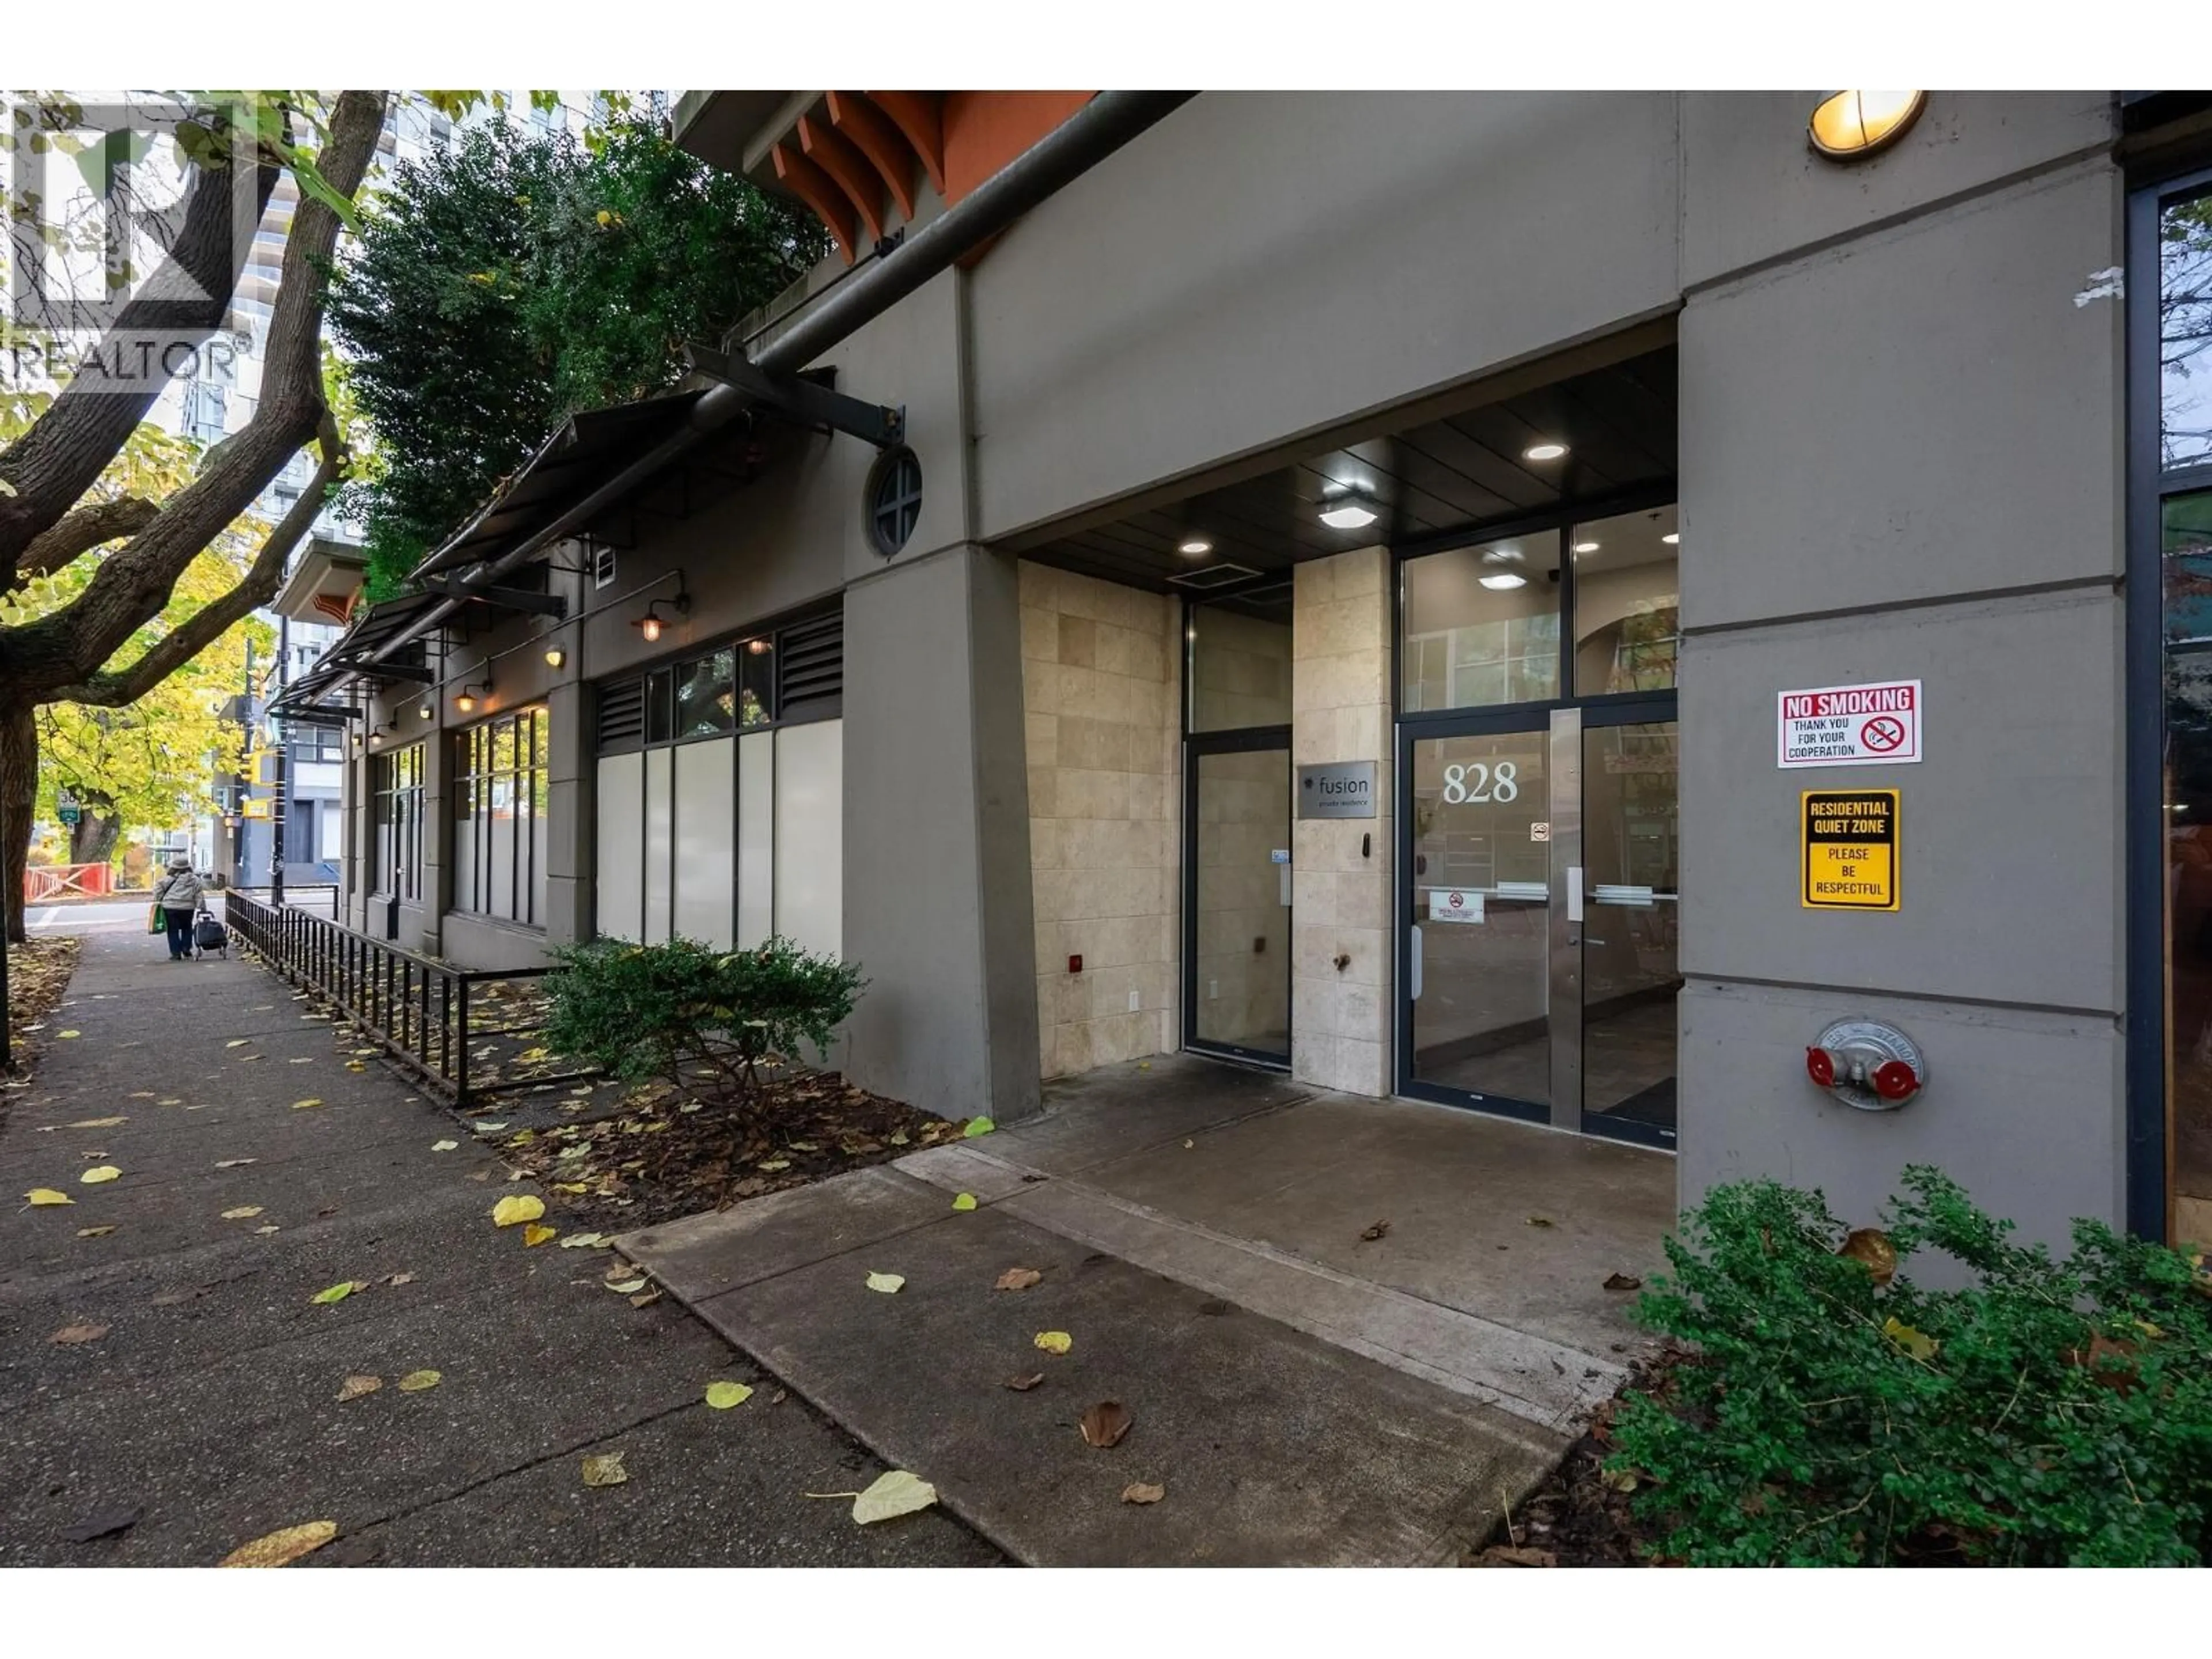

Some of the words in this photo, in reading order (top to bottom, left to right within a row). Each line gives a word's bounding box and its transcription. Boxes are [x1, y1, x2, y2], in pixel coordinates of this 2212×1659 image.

[1786, 696, 1812, 717] NO
[1817, 688, 1911, 715] SMOKING
[1794, 719, 1826, 731] THANK
[1829, 718, 1849, 729] YOU
[1798, 733, 1816, 744] FOR
[1819, 732, 1845, 743] YOUR
[1789, 745, 1855, 758] COOPERATION
[1320, 777, 1369, 794] fusion
[1444, 762, 1518, 804] 828
[1810, 801, 1890, 816] RESIDENTIAL
[1815, 820, 1849, 834] QUIET
[1851, 819, 1886, 834] ZONE
[1828, 848, 1869, 860] PLEASE
[1842, 865, 1856, 877] BE
[1816, 882, 1884, 895] RESPECTFUL
